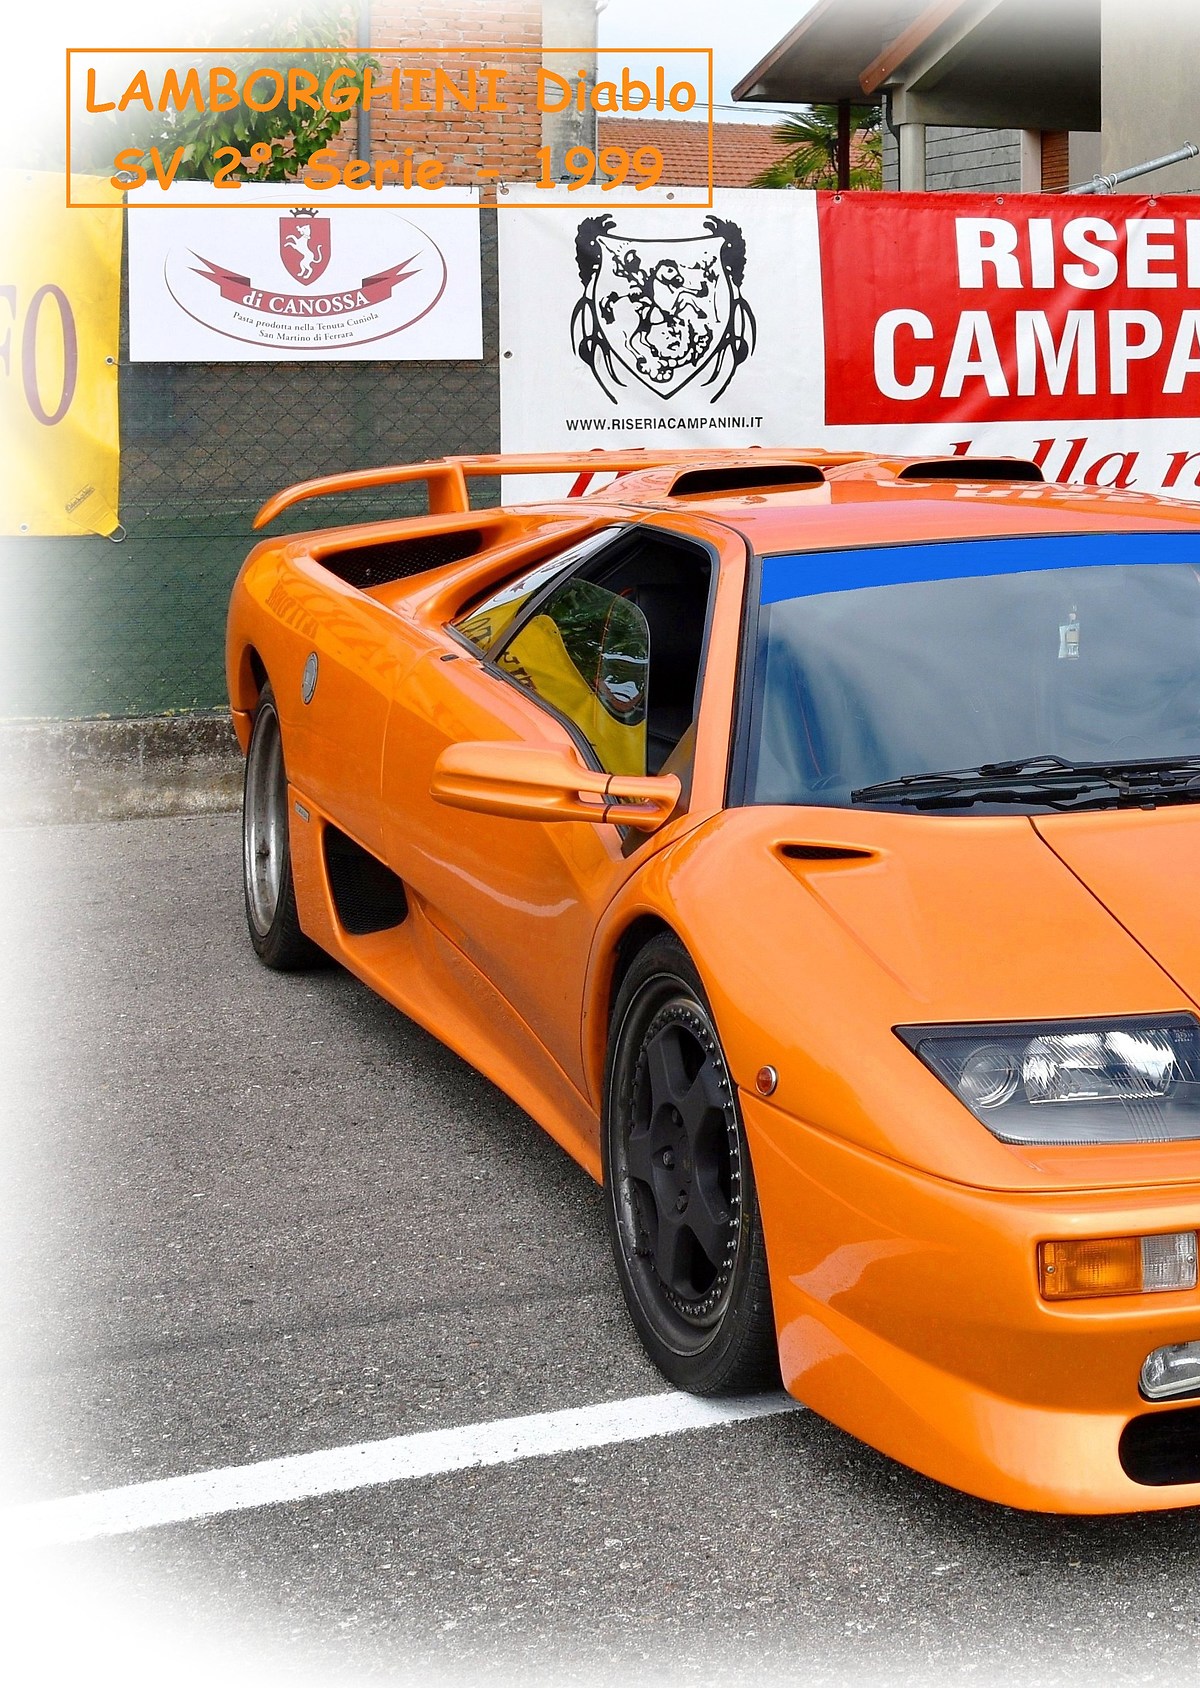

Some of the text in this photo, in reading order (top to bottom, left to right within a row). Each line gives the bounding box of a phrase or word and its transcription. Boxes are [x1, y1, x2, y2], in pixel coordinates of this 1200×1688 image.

[242, 290, 370, 315] di CANOSSA
[233, 311, 254, 324] Pasta
[255, 320, 292, 331] prodotta
[294, 323, 315, 331] nella
[316, 323, 345, 331] Tenuta
[259, 329, 354, 342] San Martino di Ferrara
[566, 416, 763, 431] WWW.RISERIACAMPANINI.IT
